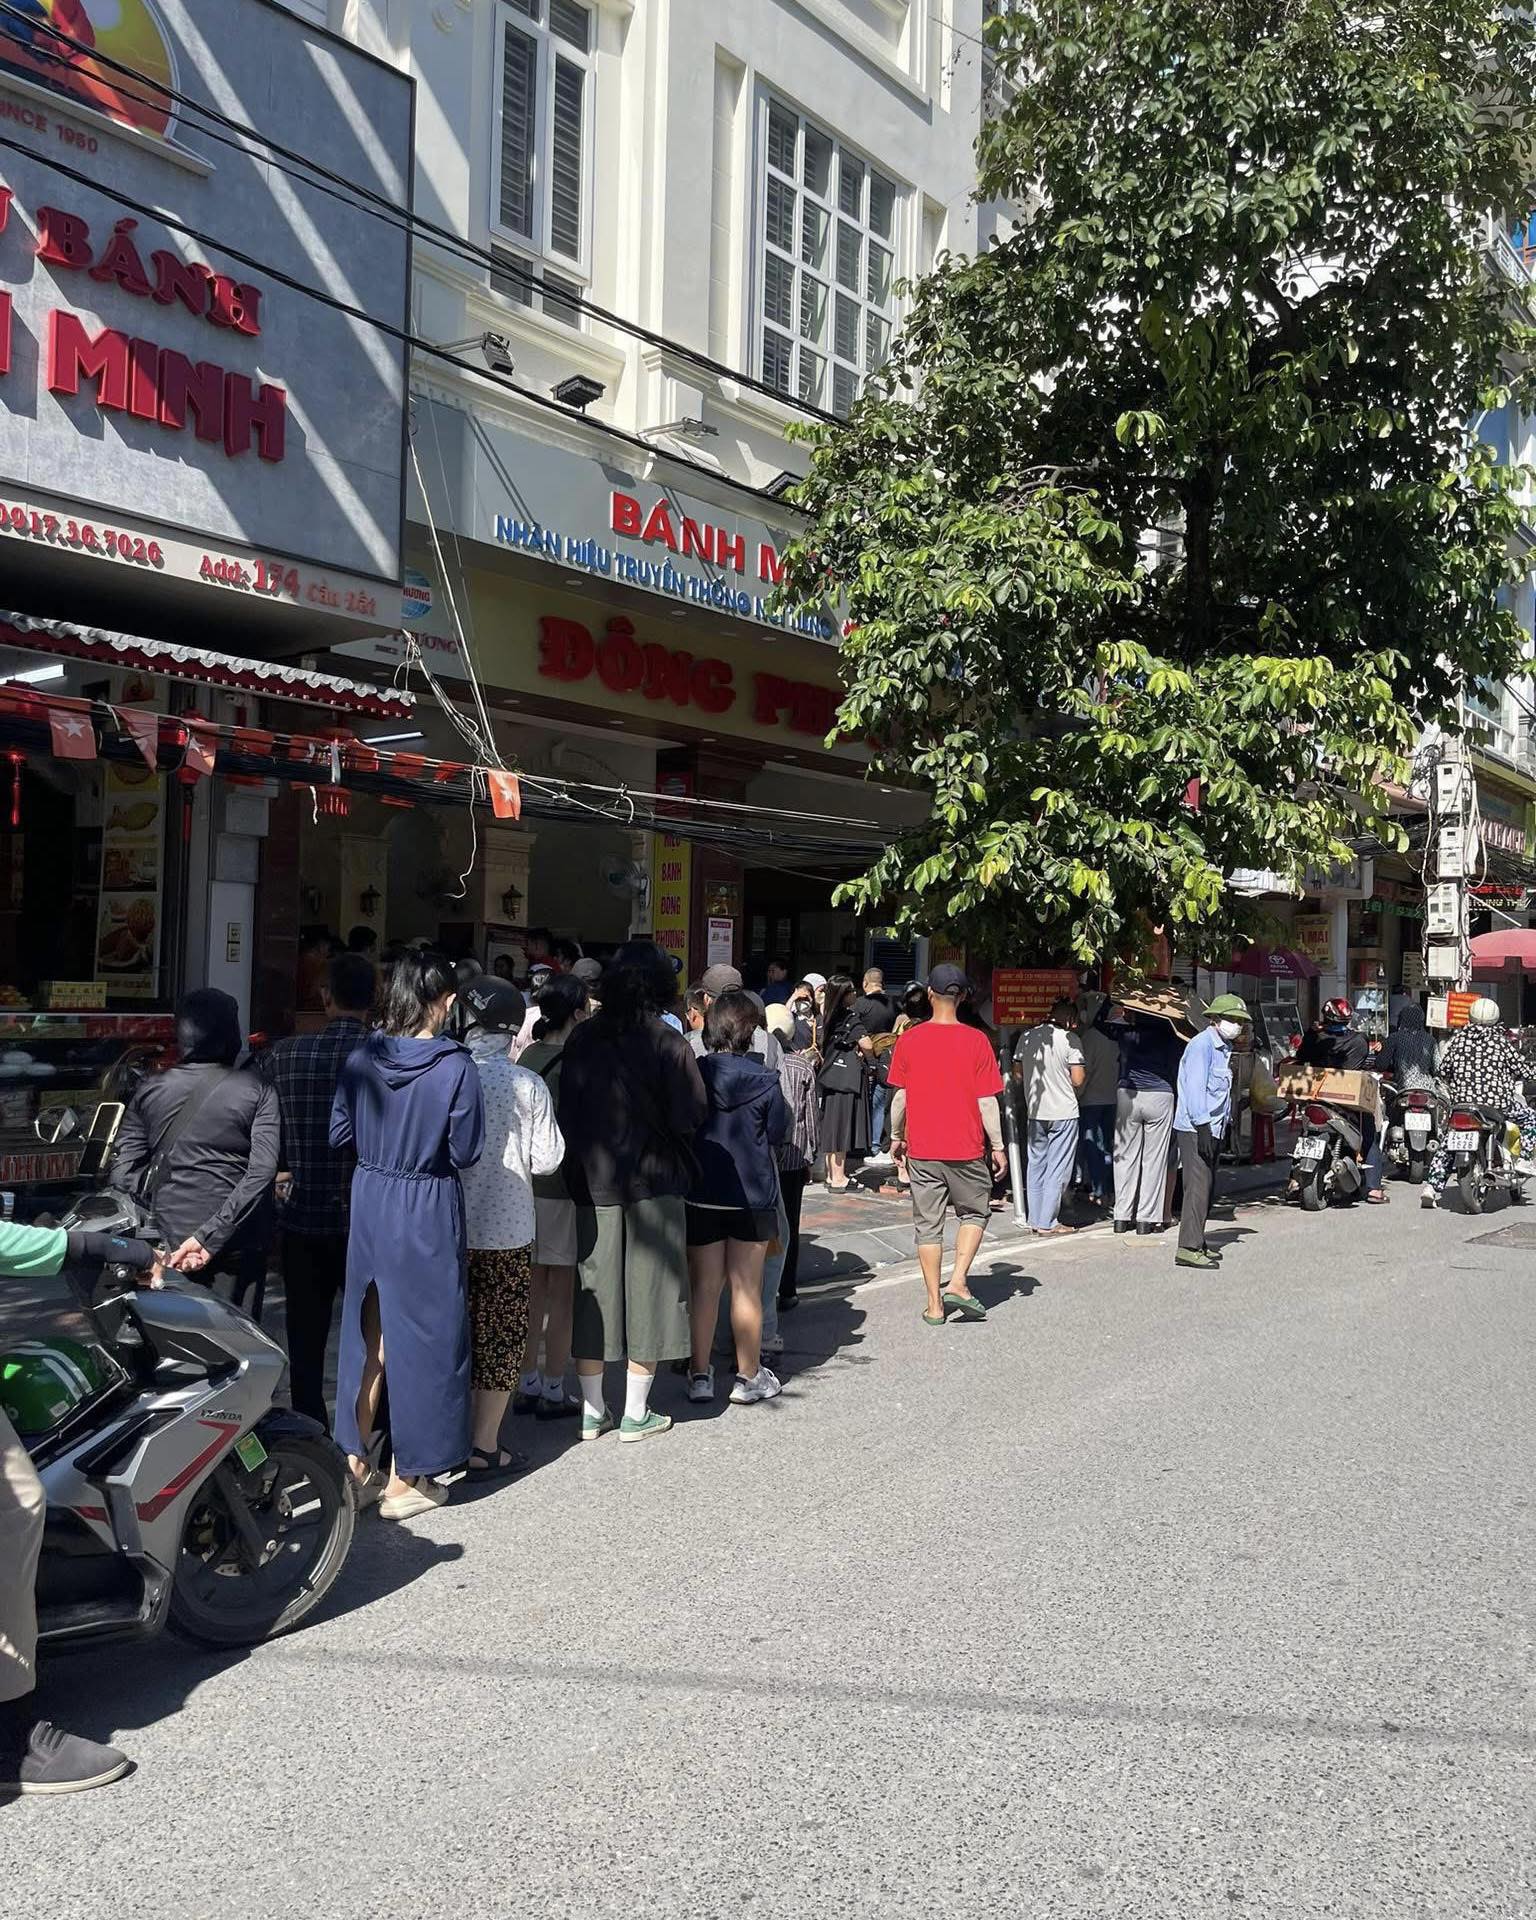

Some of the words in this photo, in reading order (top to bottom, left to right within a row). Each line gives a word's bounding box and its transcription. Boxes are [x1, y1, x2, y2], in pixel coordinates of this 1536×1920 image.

[0, 100, 48, 131] INCE
[35, 206, 262, 336] BÁNH
[48, 308, 287, 463] MINH
[610, 491, 746, 573] BÁNH
[254, 558, 299, 598] 174
[537, 615, 736, 713] ĐÔNG
